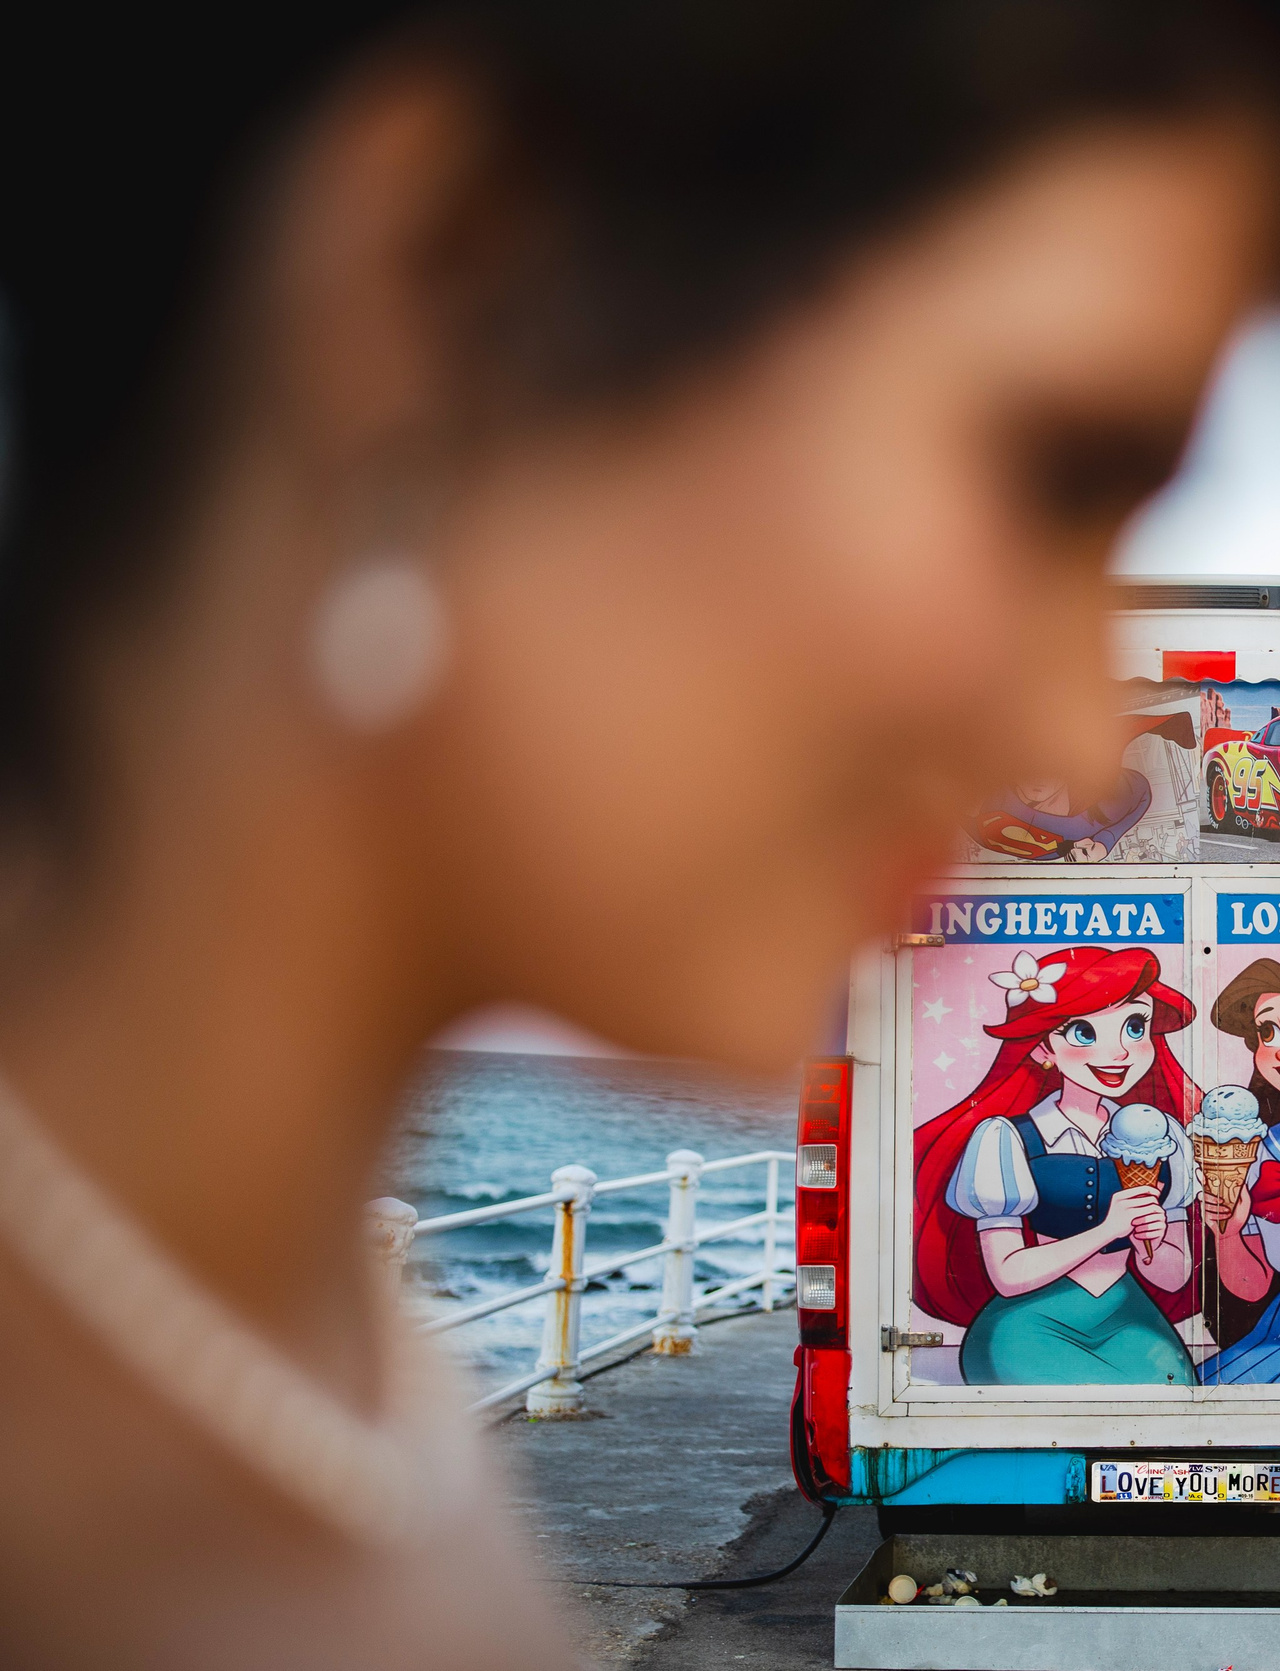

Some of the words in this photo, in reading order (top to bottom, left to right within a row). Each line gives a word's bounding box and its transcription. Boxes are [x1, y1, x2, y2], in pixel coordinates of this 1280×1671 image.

[1232, 757, 1268, 811] 95
[929, 902, 1165, 936] INGHETATA
[1102, 1472, 1164, 1496] LOVE
[1175, 1473, 1217, 1496] YOU
